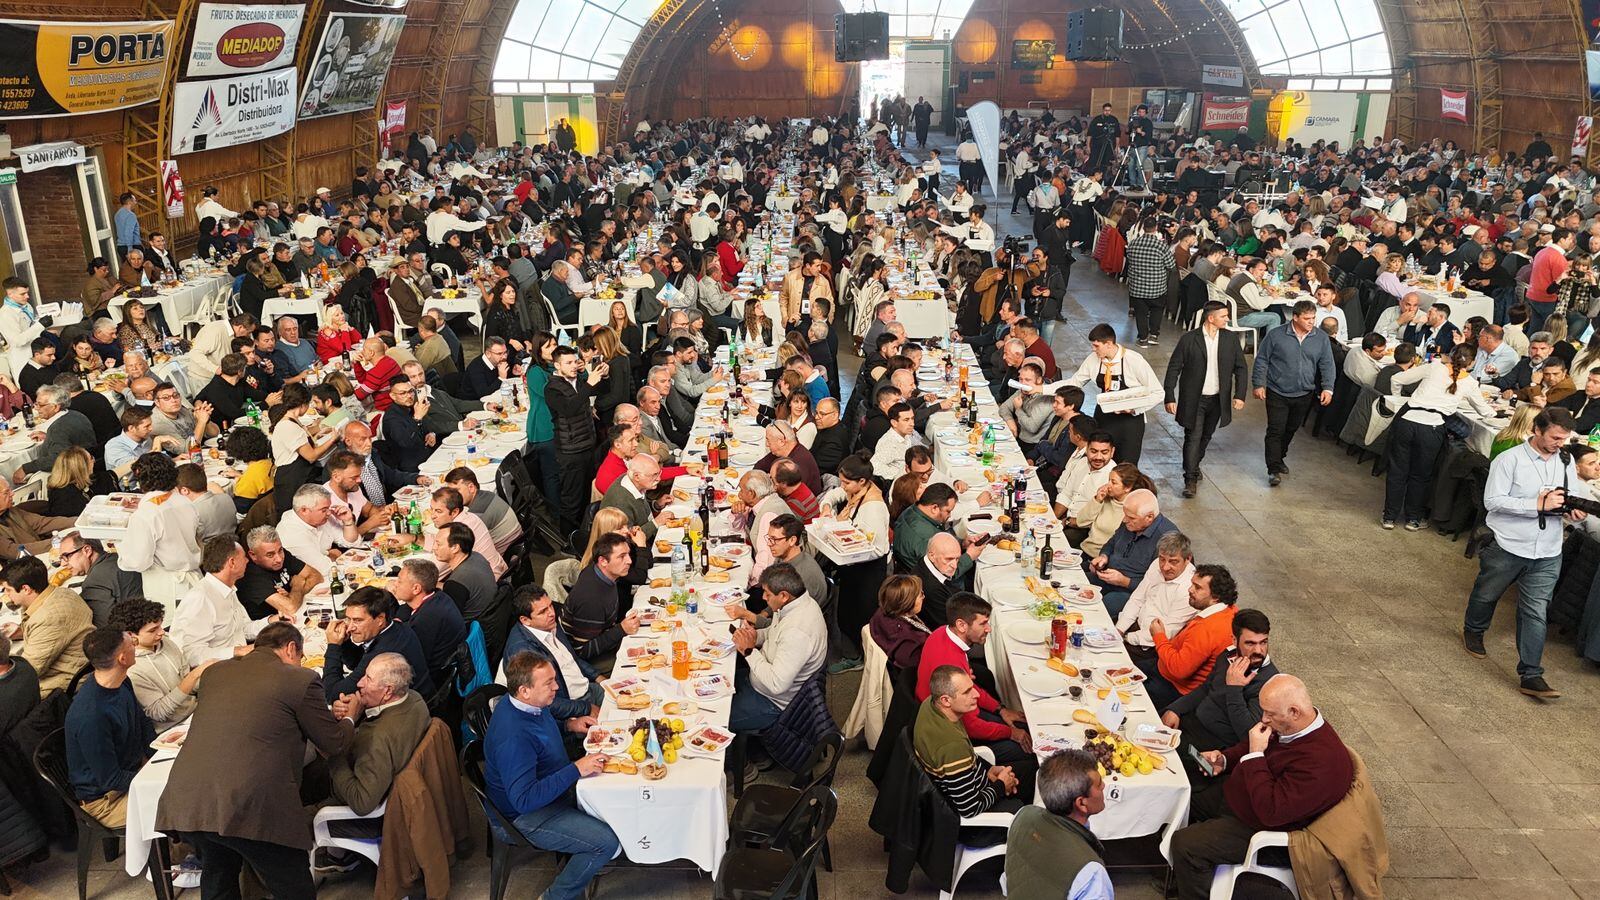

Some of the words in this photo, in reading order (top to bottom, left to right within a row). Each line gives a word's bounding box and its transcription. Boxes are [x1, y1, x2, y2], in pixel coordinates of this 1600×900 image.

[211, 9, 234, 20] FRUTAS
[235, 10, 267, 20] DESECADAS
[268, 10, 274, 20] DE
[275, 9, 299, 20] MENDOZA
[68, 33, 165, 66] PORTA
[222, 36, 282, 55] MEDIADOR
[228, 77, 289, 106] Distri-Max
[239, 104, 282, 122] Distribuidora
[1208, 110, 1245, 121] Schneider
[27, 147, 79, 165] SANITARIOS
[642, 790, 651, 800] 5
[1110, 788, 1120, 799] 6
